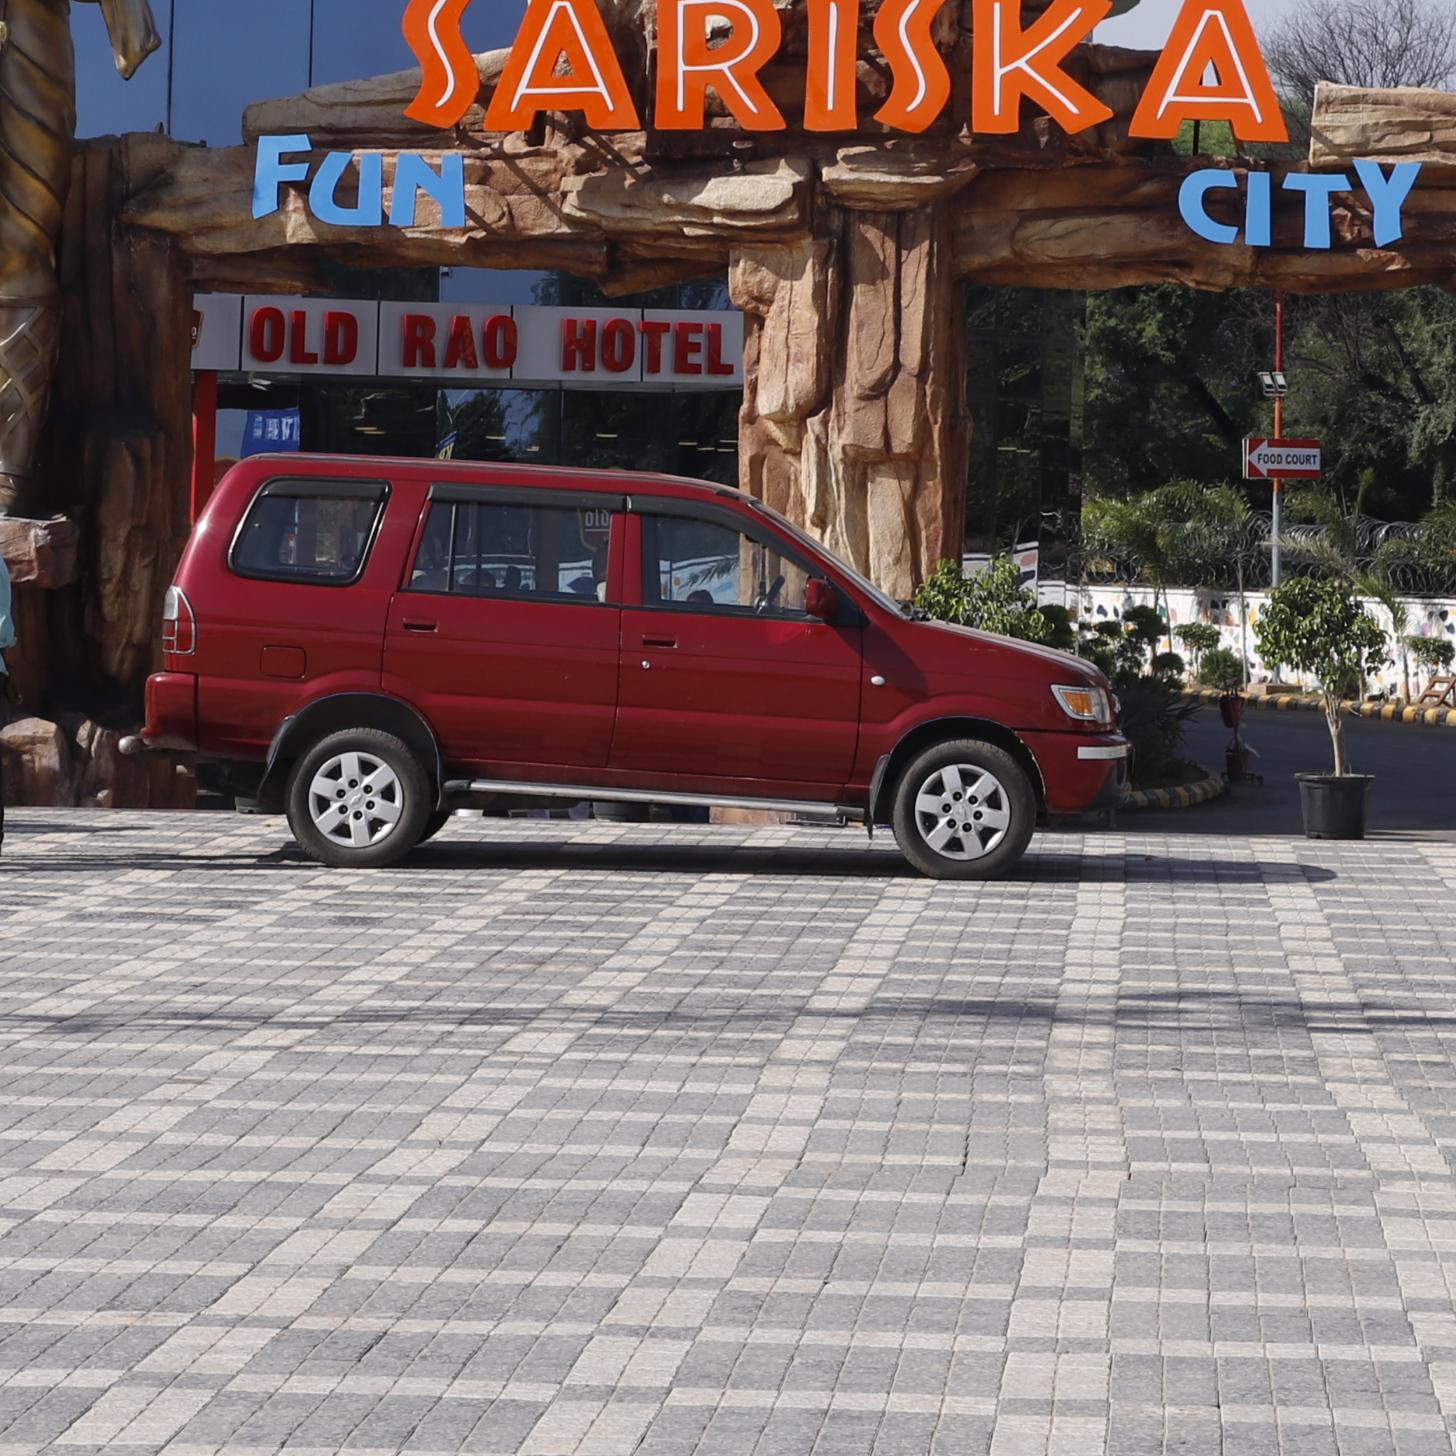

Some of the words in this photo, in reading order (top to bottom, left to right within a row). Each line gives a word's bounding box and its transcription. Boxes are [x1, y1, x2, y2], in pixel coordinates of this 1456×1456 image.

[252, 133, 466, 228] FUN
[1179, 159, 1422, 249] CITY
[249, 306, 359, 366] OLD
[402, 313, 519, 370] RAO
[561, 317, 735, 376] HOTEL
[1257, 453, 1283, 465] FOOD
[1285, 454, 1318, 465] COURT
